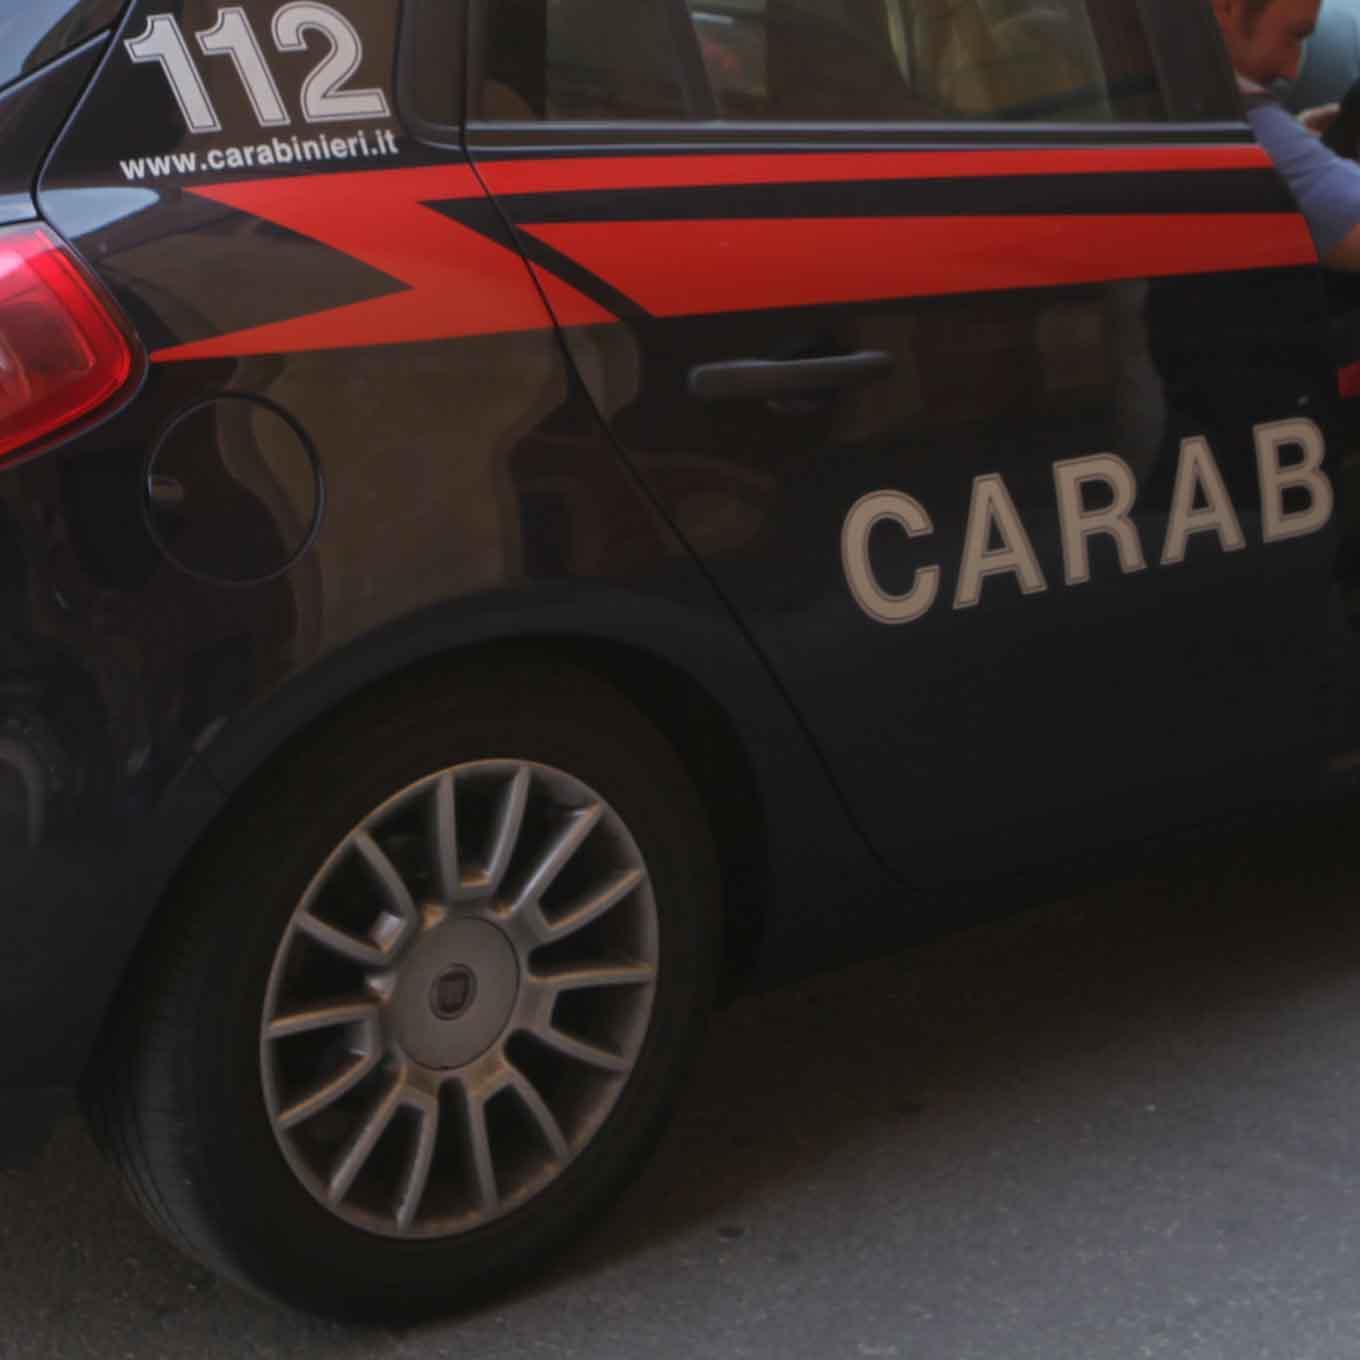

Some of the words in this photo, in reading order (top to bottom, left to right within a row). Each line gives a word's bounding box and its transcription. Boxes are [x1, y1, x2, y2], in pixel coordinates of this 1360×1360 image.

[122, 0, 391, 133] 112
[120, 129, 399, 180] www.carabinieri.it
[840, 416, 1335, 626] CARAB
